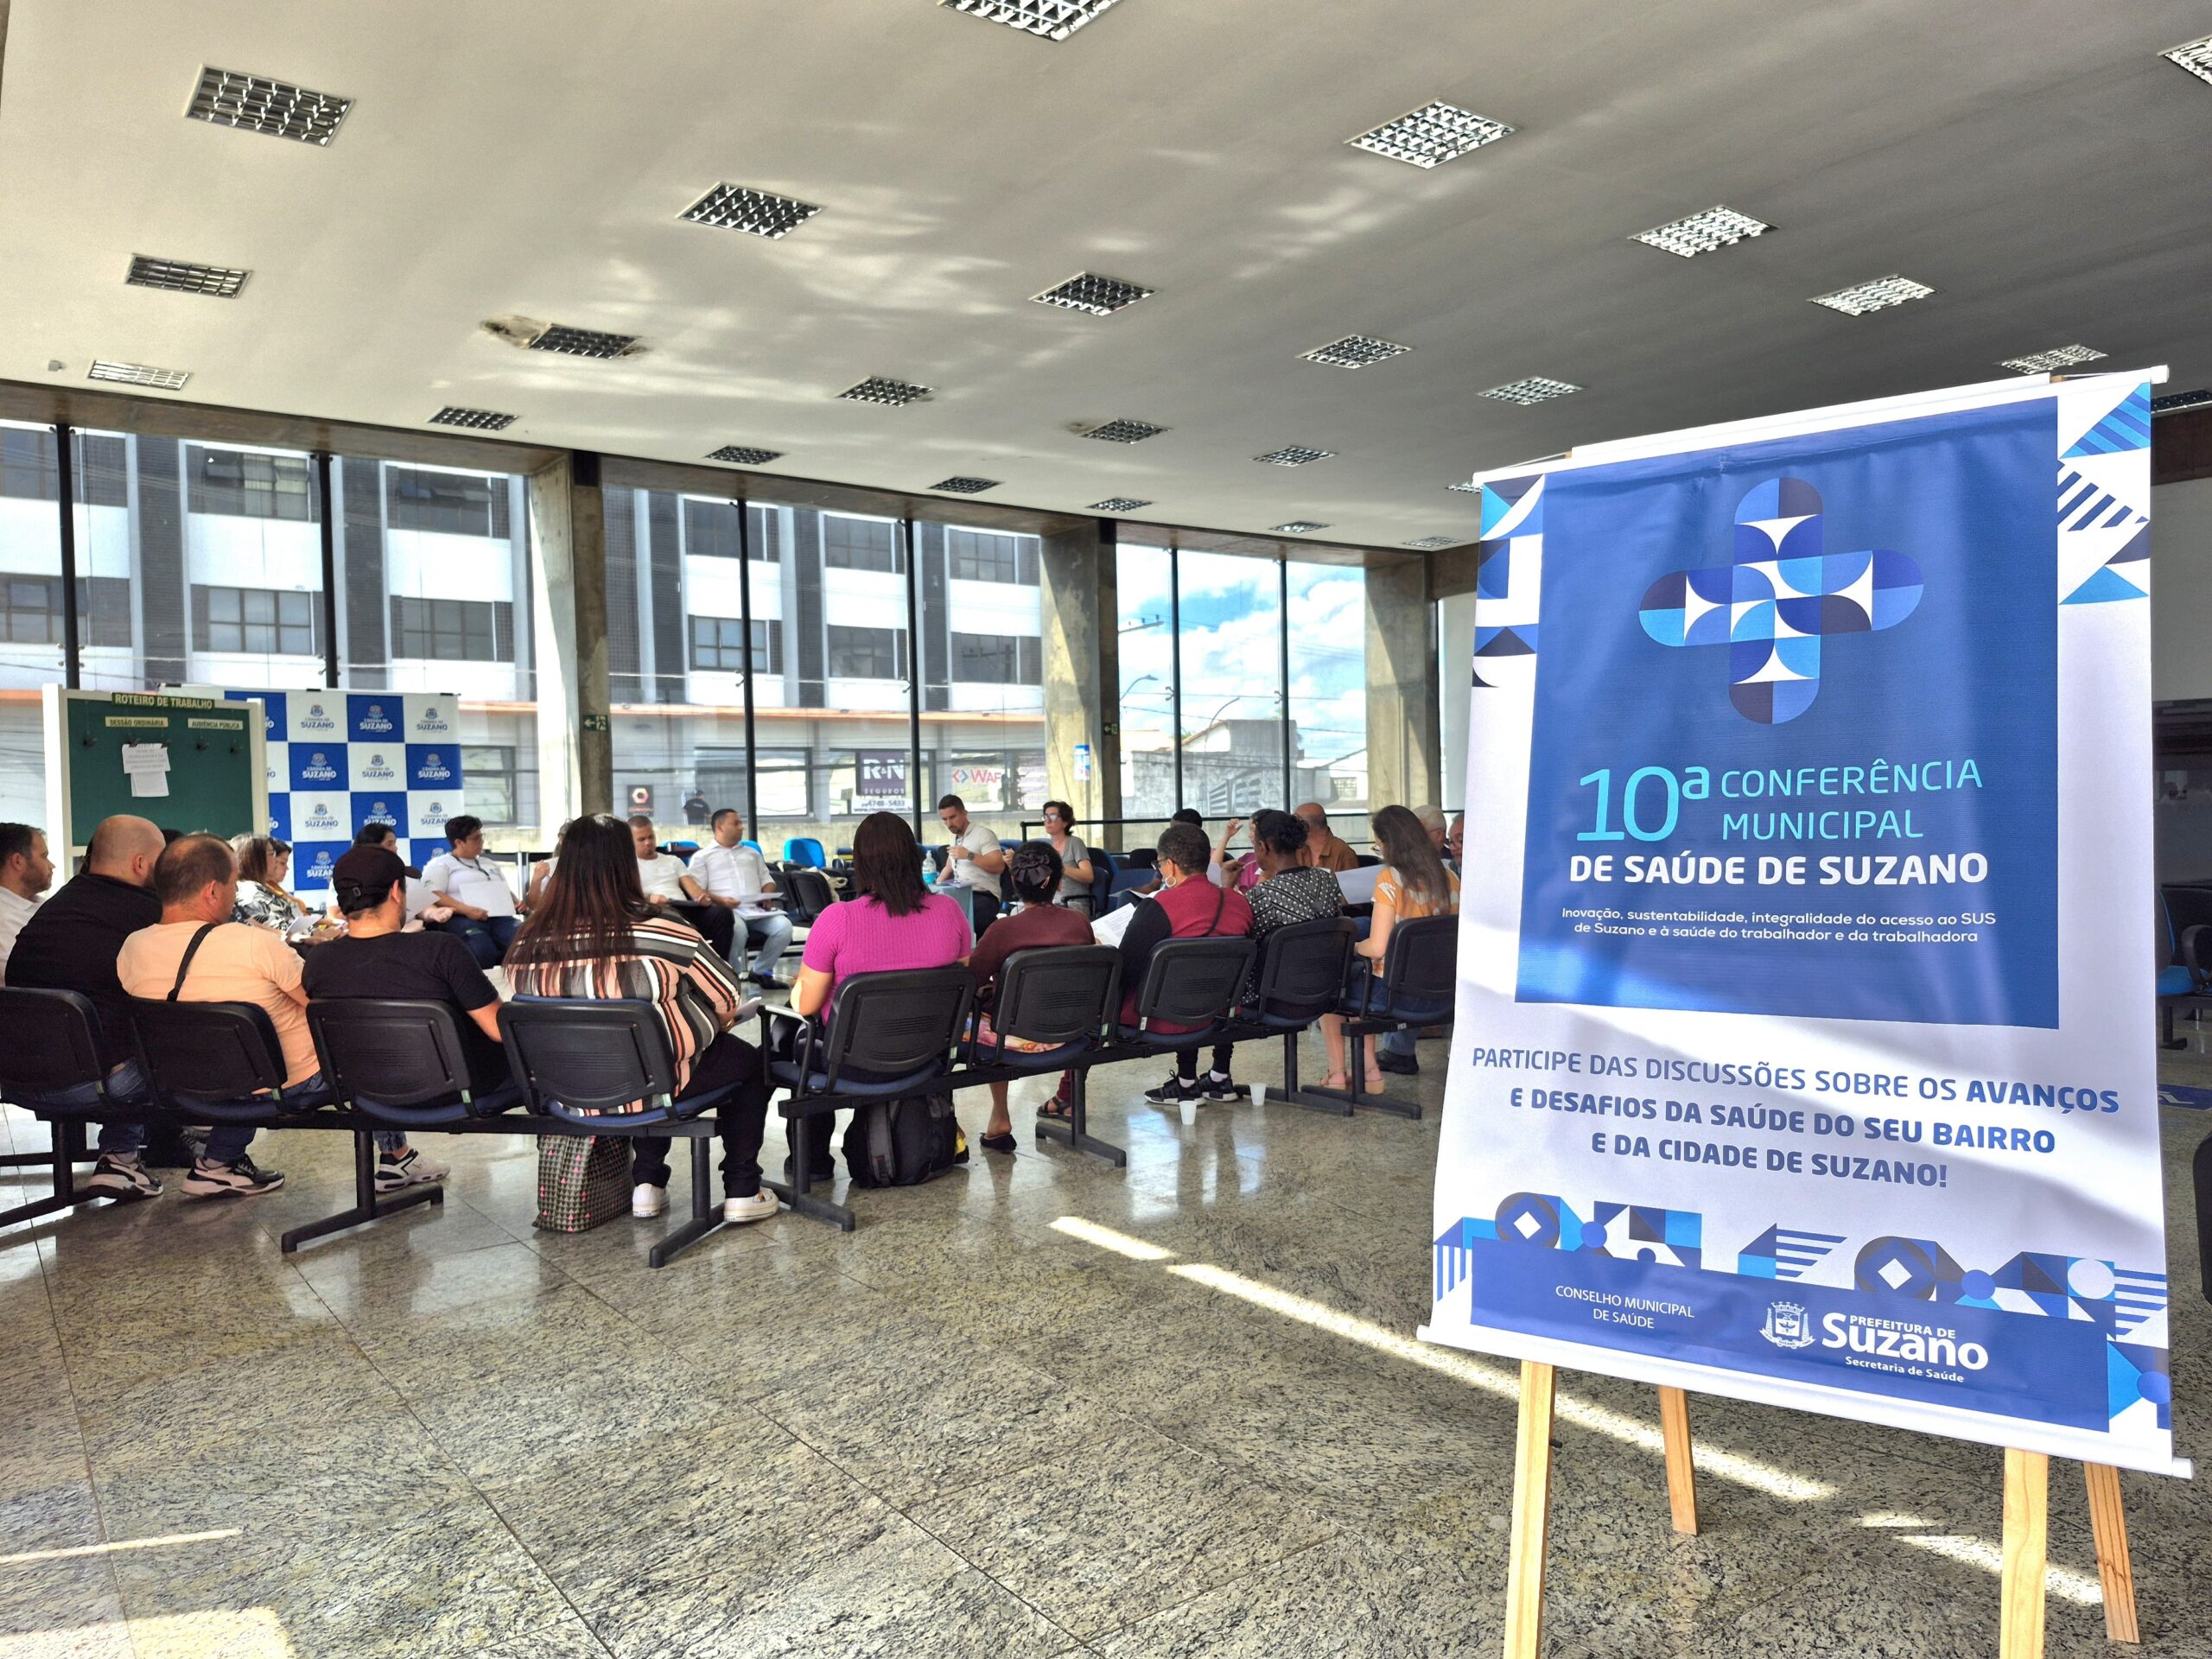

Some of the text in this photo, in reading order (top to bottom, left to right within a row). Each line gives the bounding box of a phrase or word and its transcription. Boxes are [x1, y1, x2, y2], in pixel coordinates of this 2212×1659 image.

[115, 694, 213, 709] ROTEIRO DE TRABALHO
[418, 770, 450, 779] SUZANO
[1721, 758, 1983, 798] CONFERÊNCIA
[1722, 809, 1923, 841] MUNICIPAL
[1570, 850, 1988, 886] DE SAÚDE DE SUZANO
[1561, 907, 1996, 927] Inovação, sustentabilidade, integralidade do acesso ao SUS
[1574, 923, 1591, 933] de
[1594, 923, 1644, 936] Suzano
[1660, 925, 1669, 937] à
[1672, 925, 1716, 938] saúde
[1719, 927, 1738, 938] do
[1741, 928, 1831, 940] trabalhador
[1834, 931, 1844, 941] e
[1848, 930, 1868, 941] da
[1872, 931, 1978, 943] trabalhadora
[1472, 1047, 2120, 1115] PARTICIPE DAS DISCUSSÕES SOBRE OS AVANÇOS
[1510, 1088, 2056, 1154] E DESAFIOS DA SAÚDE DO SEU BAIRRO
[1592, 1132, 1948, 1188] E DA CIDADE DE SUZANO!
[1555, 1285, 1695, 1319] CONSELHO MUNICIPAL
[1593, 1308, 1655, 1329] DE SAÚDE
[1849, 1314, 1956, 1339] PREFEITURA DE
[1821, 1312, 1989, 1370] Suzano
[1845, 1356, 1964, 1383] Secretaria de Saúde
